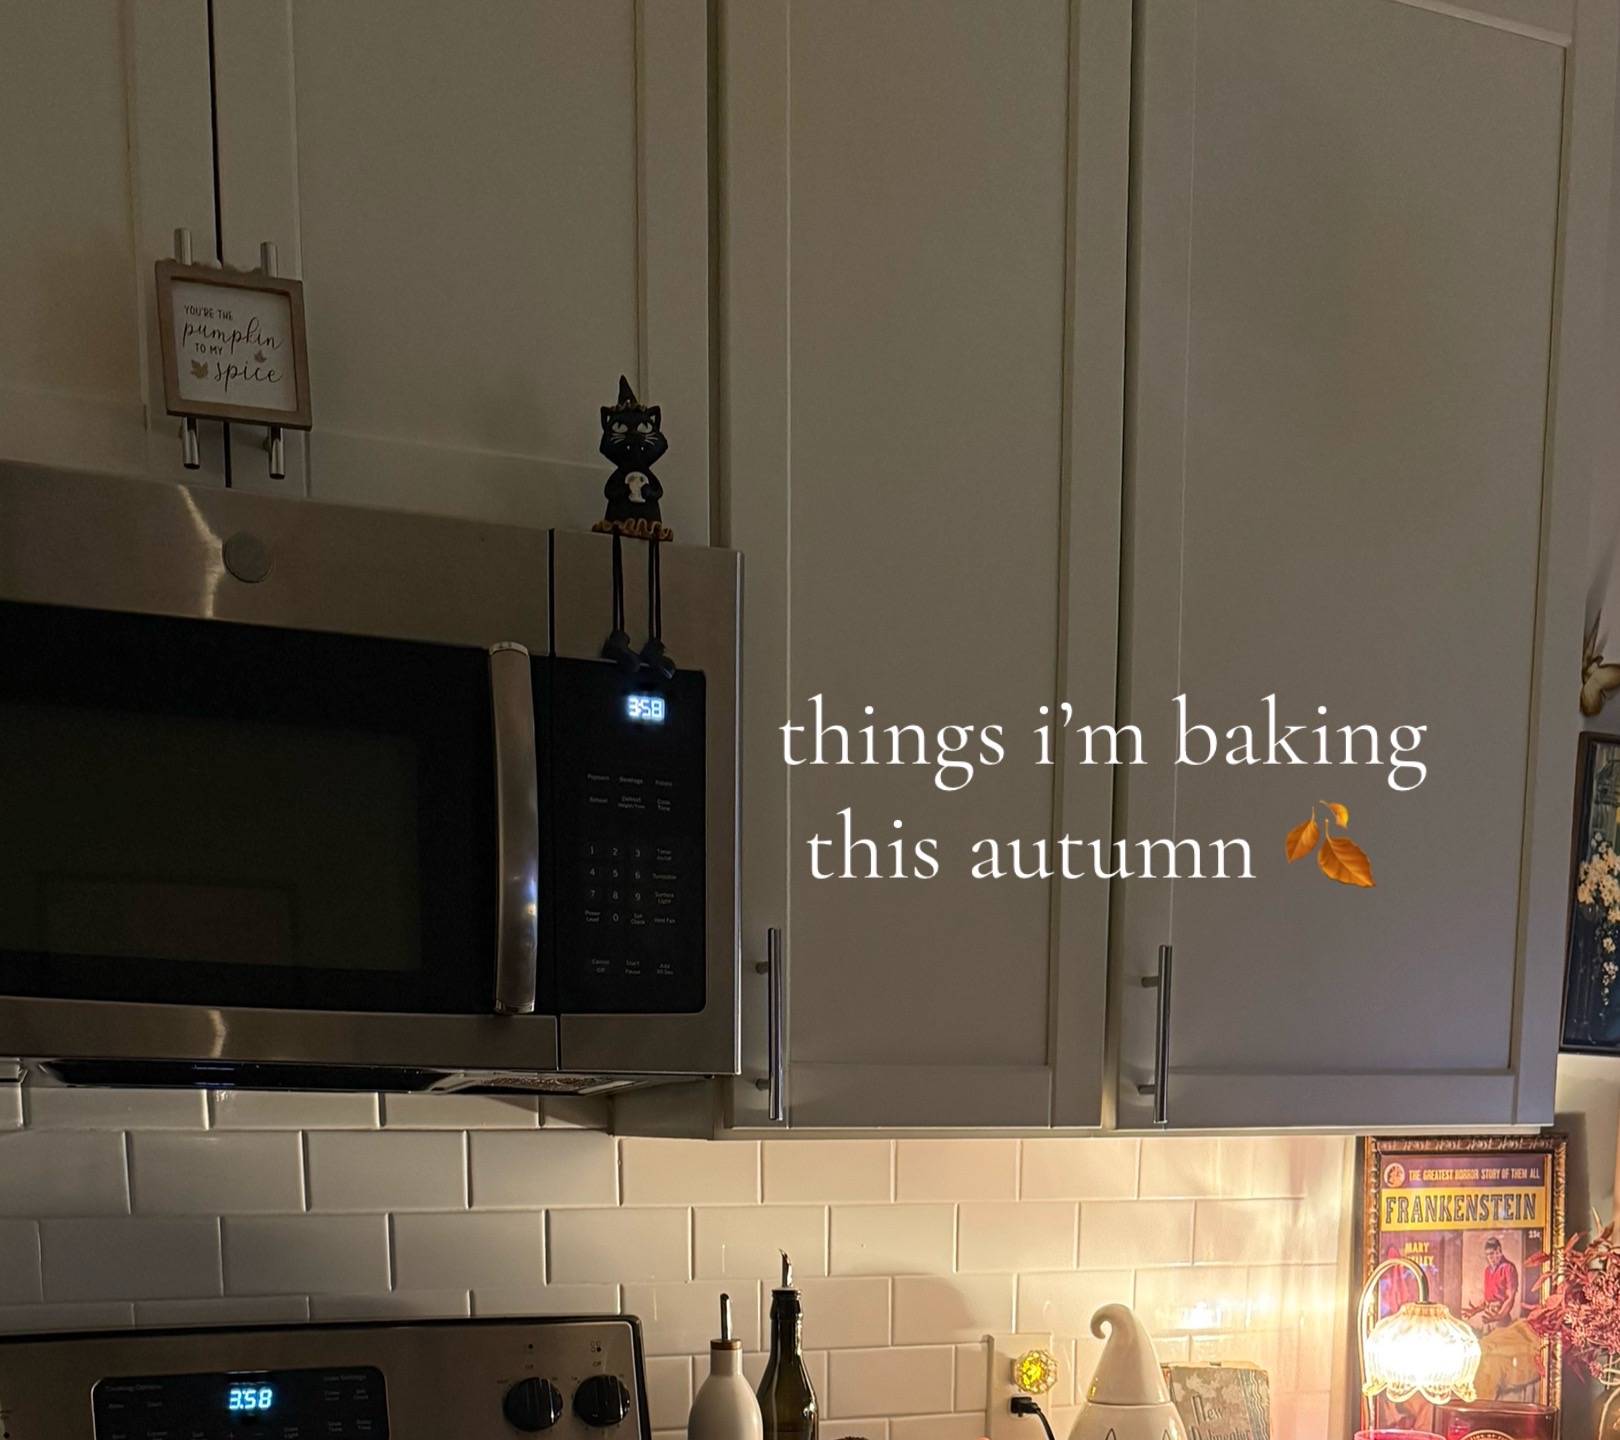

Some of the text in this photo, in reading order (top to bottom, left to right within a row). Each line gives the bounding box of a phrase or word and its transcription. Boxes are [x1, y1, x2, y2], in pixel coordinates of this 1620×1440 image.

[218, 308, 233, 321] THE
[182, 316, 283, 355] pumpkin
[195, 342, 223, 355] TO MY
[214, 361, 282, 392] spice
[1409, 1167, 1540, 1181] THE GREATEST HORROR STORY OF THEM ALL
[1385, 1193, 1537, 1224] FRANKENSTEIN
[1404, 1242, 1430, 1254] MARY
[1190, 1394, 1225, 1425] New
